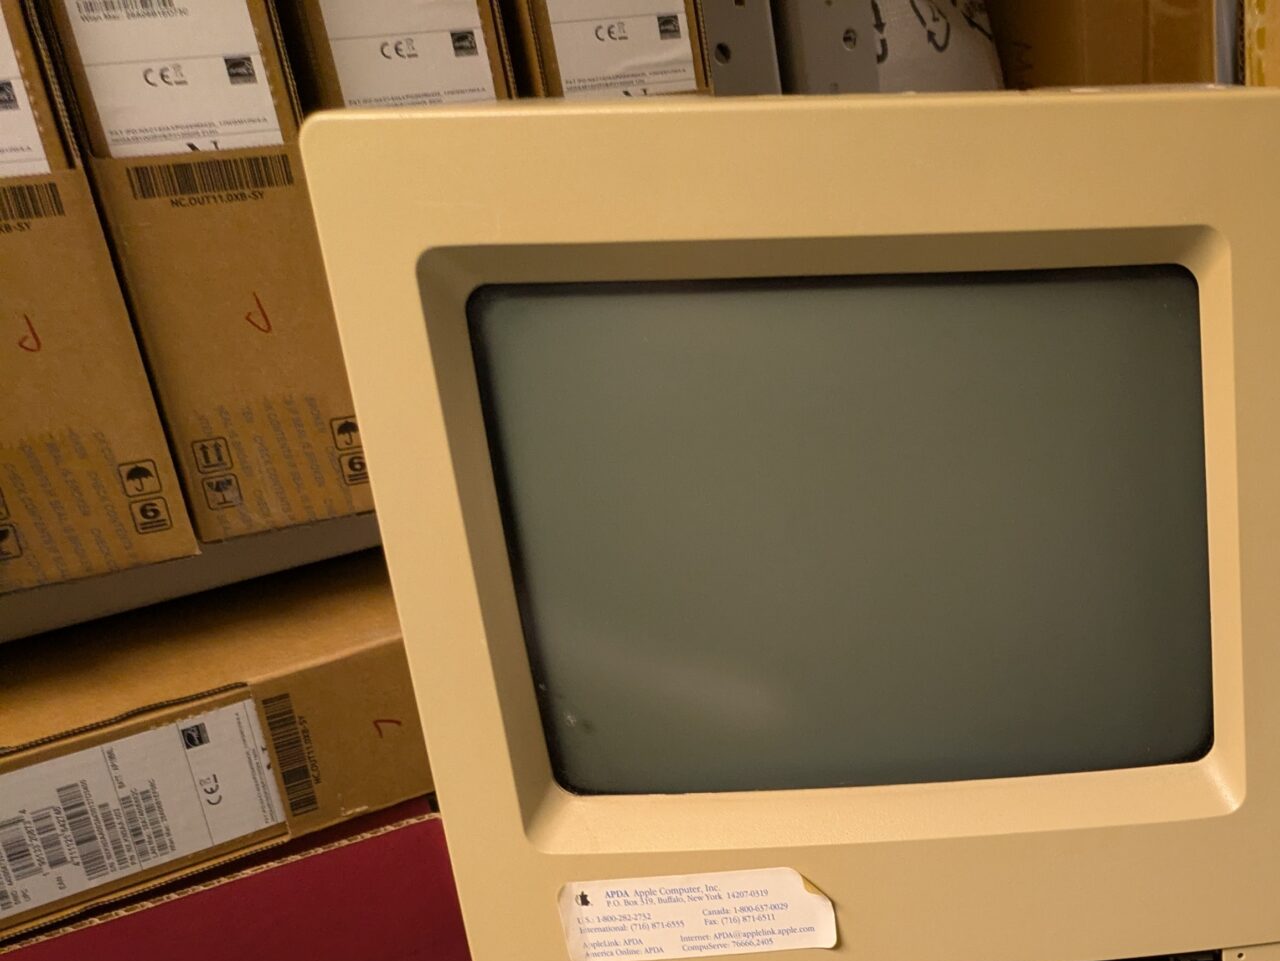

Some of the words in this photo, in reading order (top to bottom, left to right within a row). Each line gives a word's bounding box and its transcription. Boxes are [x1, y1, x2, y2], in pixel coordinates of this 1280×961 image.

[605, 890, 630, 899] APDA
[633, 888, 657, 899] Apple
[658, 885, 703, 896] Computer,
[704, 884, 721, 893] Inc.
[623, 897, 639, 906] Box
[657, 895, 687, 905] Buffalo,
[687, 895, 704, 903] New
[704, 893, 723, 901] York
[721, 916, 740, 926] (716)
[630, 922, 650, 932] (716)
[622, 938, 644, 946] APDA
[644, 946, 665, 954] APDA
